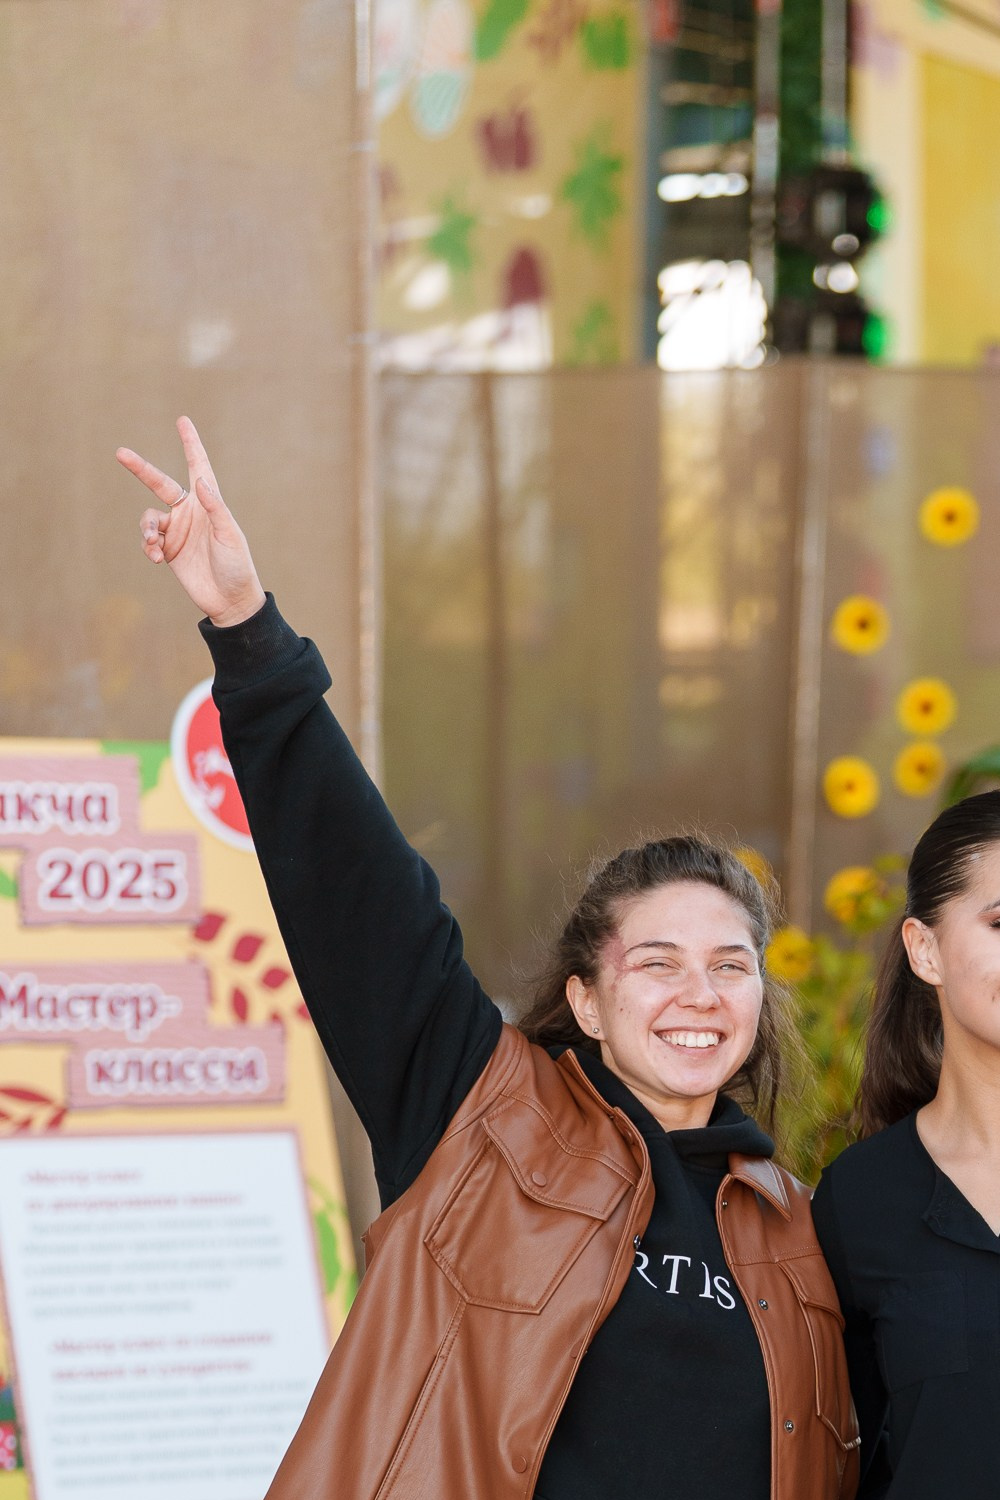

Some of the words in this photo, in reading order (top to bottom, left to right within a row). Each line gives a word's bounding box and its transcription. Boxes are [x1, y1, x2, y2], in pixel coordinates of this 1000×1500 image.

[0, 794, 108, 823] кча
[48, 859, 177, 901] 2025
[94, 1058, 259, 1085] классы
